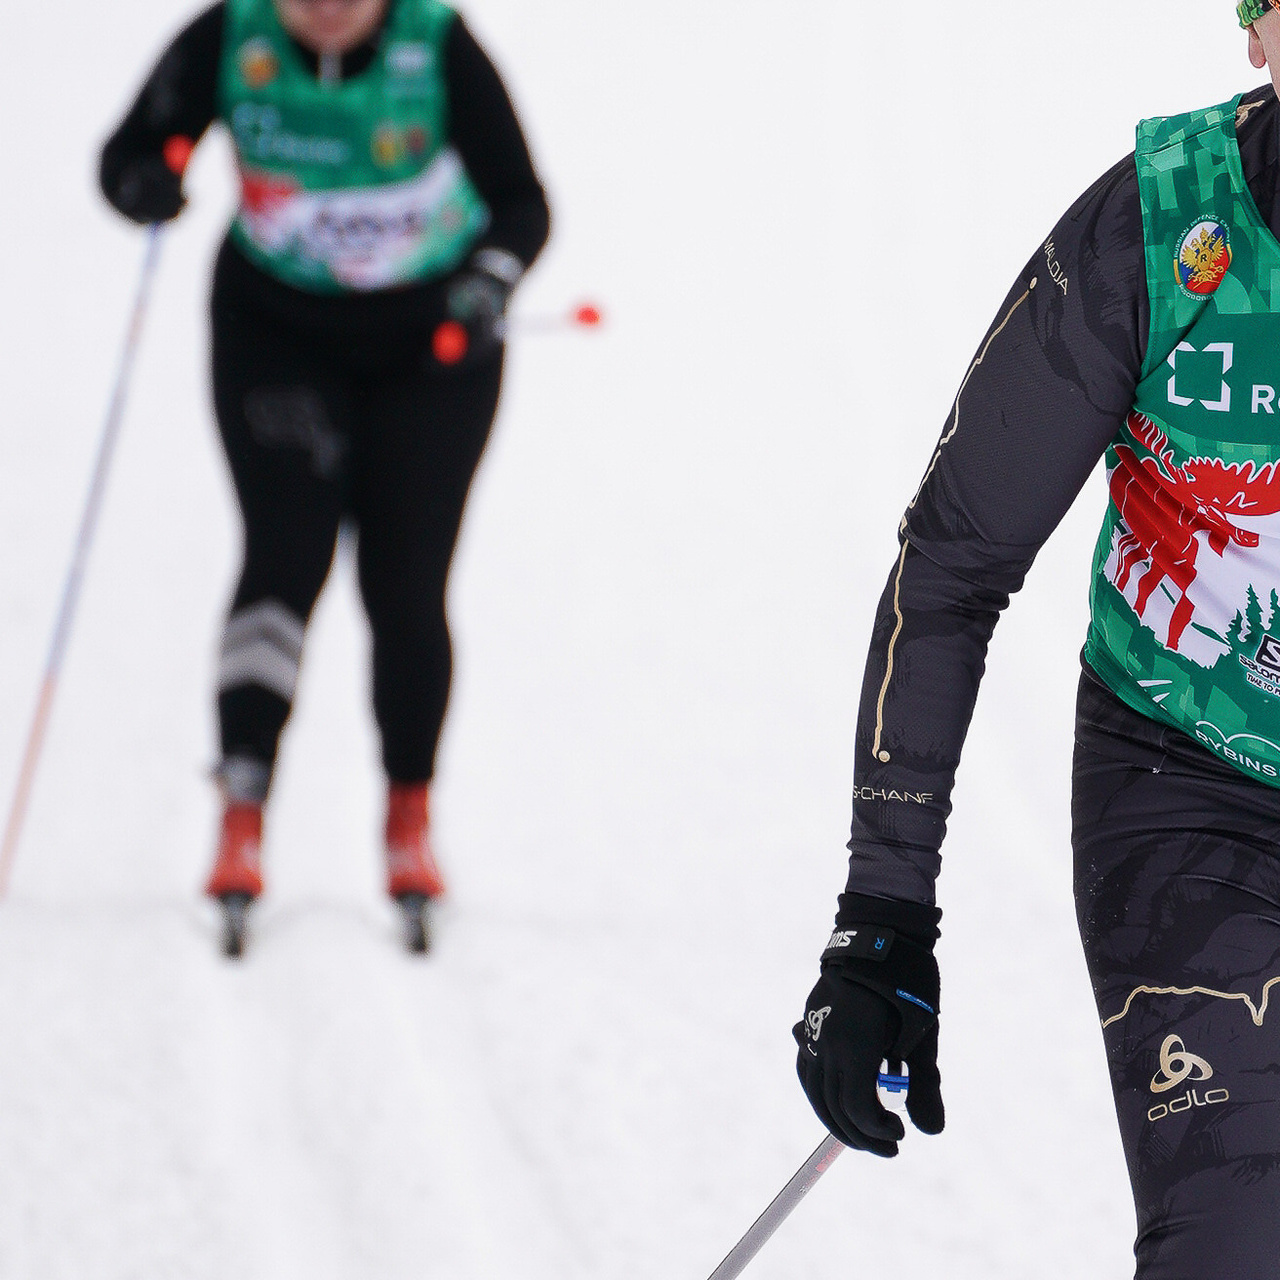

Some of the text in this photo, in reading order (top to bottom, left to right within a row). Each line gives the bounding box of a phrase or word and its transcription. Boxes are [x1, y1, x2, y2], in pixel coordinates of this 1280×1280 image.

[1044, 235, 1068, 296] MALOJA
[1247, 673, 1262, 688] TIME
[1263, 682, 1274, 692] TO
[874, 936, 885, 950] R
[1147, 1088, 1230, 1122] odlo
